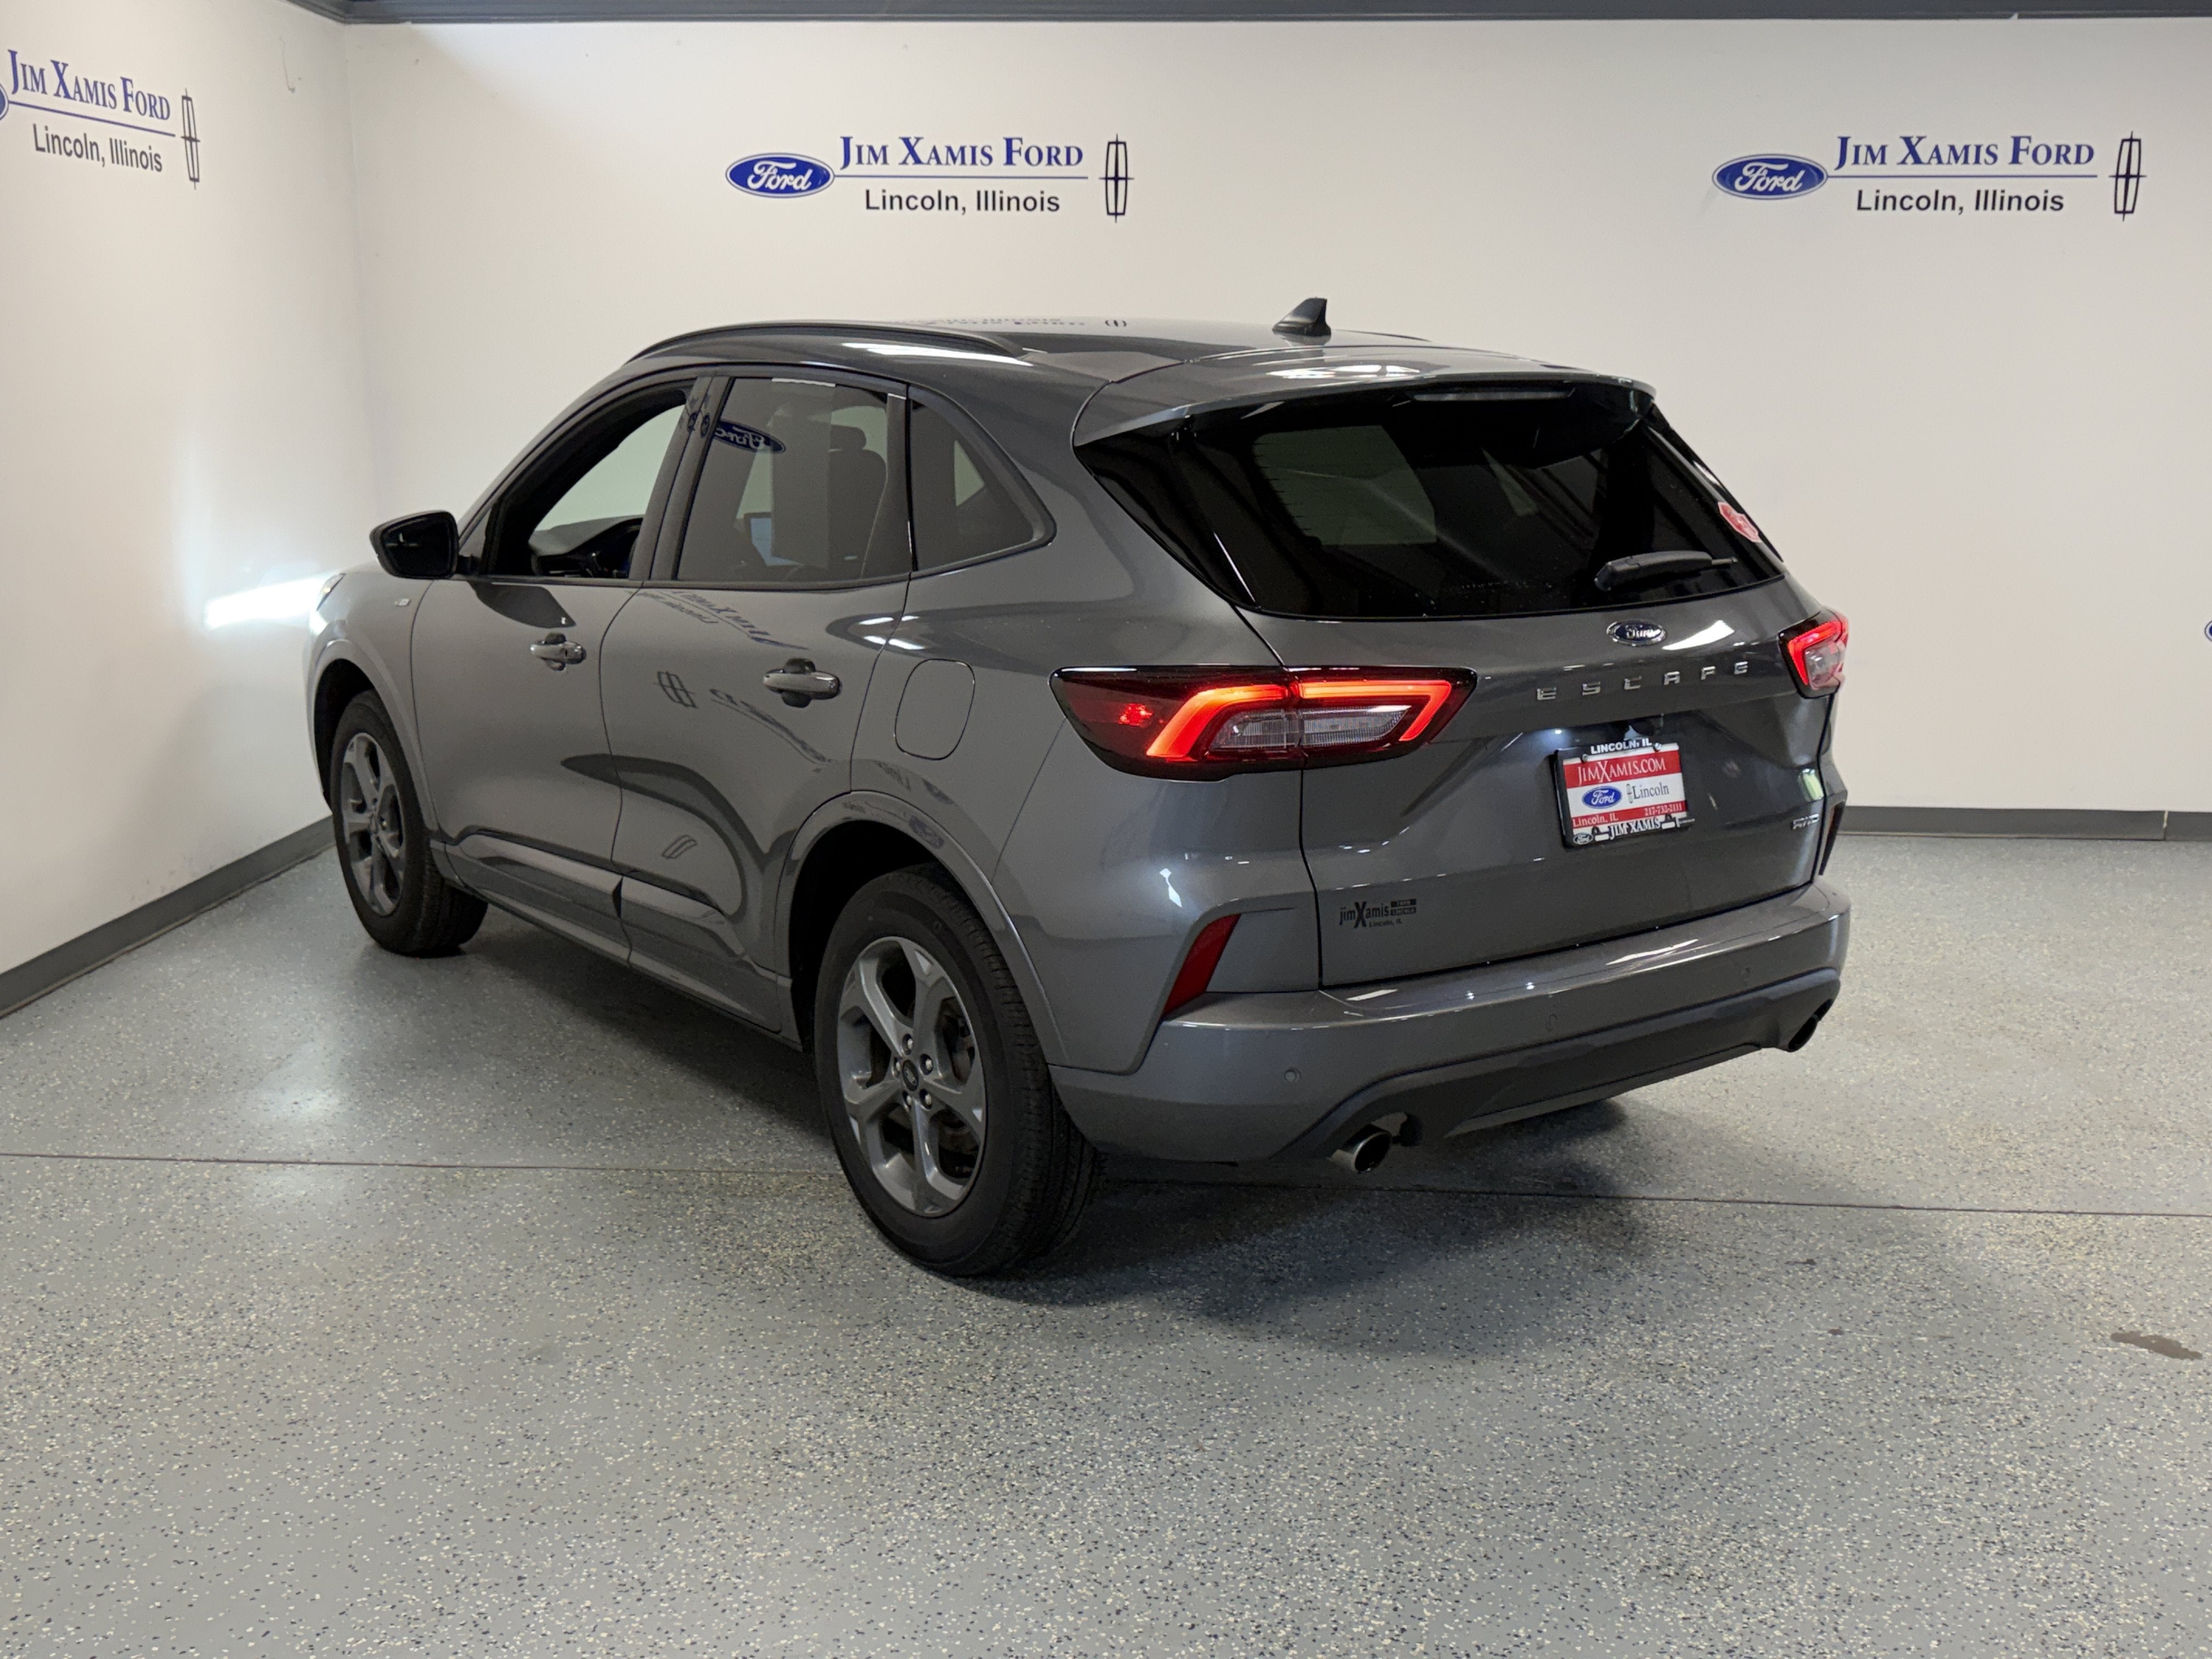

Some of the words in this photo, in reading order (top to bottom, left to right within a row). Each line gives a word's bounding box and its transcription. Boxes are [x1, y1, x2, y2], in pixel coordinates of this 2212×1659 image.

[8, 49, 48, 95] JIM
[50, 59, 118, 110] XAMIS
[120, 76, 171, 121] FORD
[33, 123, 105, 167] Lincoln,
[109, 138, 163, 172] Illinois
[840, 136, 889, 168] JIM
[899, 136, 994, 166] XAMIS
[1003, 137, 1084, 166] FORD
[1834, 136, 1888, 170] JIM
[1897, 136, 1999, 166] XAMIS
[2008, 135, 2095, 165] FORD
[747, 160, 814, 190] Ford
[1735, 161, 1806, 192] Ford
[865, 189, 966, 215] Lincoln,
[976, 190, 1060, 212] Illinois
[1856, 189, 1963, 215] Lincoln,
[1974, 189, 2064, 212] Illinois
[1537, 661, 1748, 701] ESCAPE
[1591, 740, 1640, 754] LINCOLN,
[1642, 737, 1652, 747] IL
[1577, 758, 1667, 787] JIMXAMIS.COM
[1592, 789, 1616, 805] Ford
[1632, 782, 1669, 799] Lincoln
[1572, 814, 1608, 828] Lincoln,
[1609, 812, 1618, 821] IL
[1609, 823, 1629, 840] JIM
[1630, 817, 1661, 833] XAMIS
